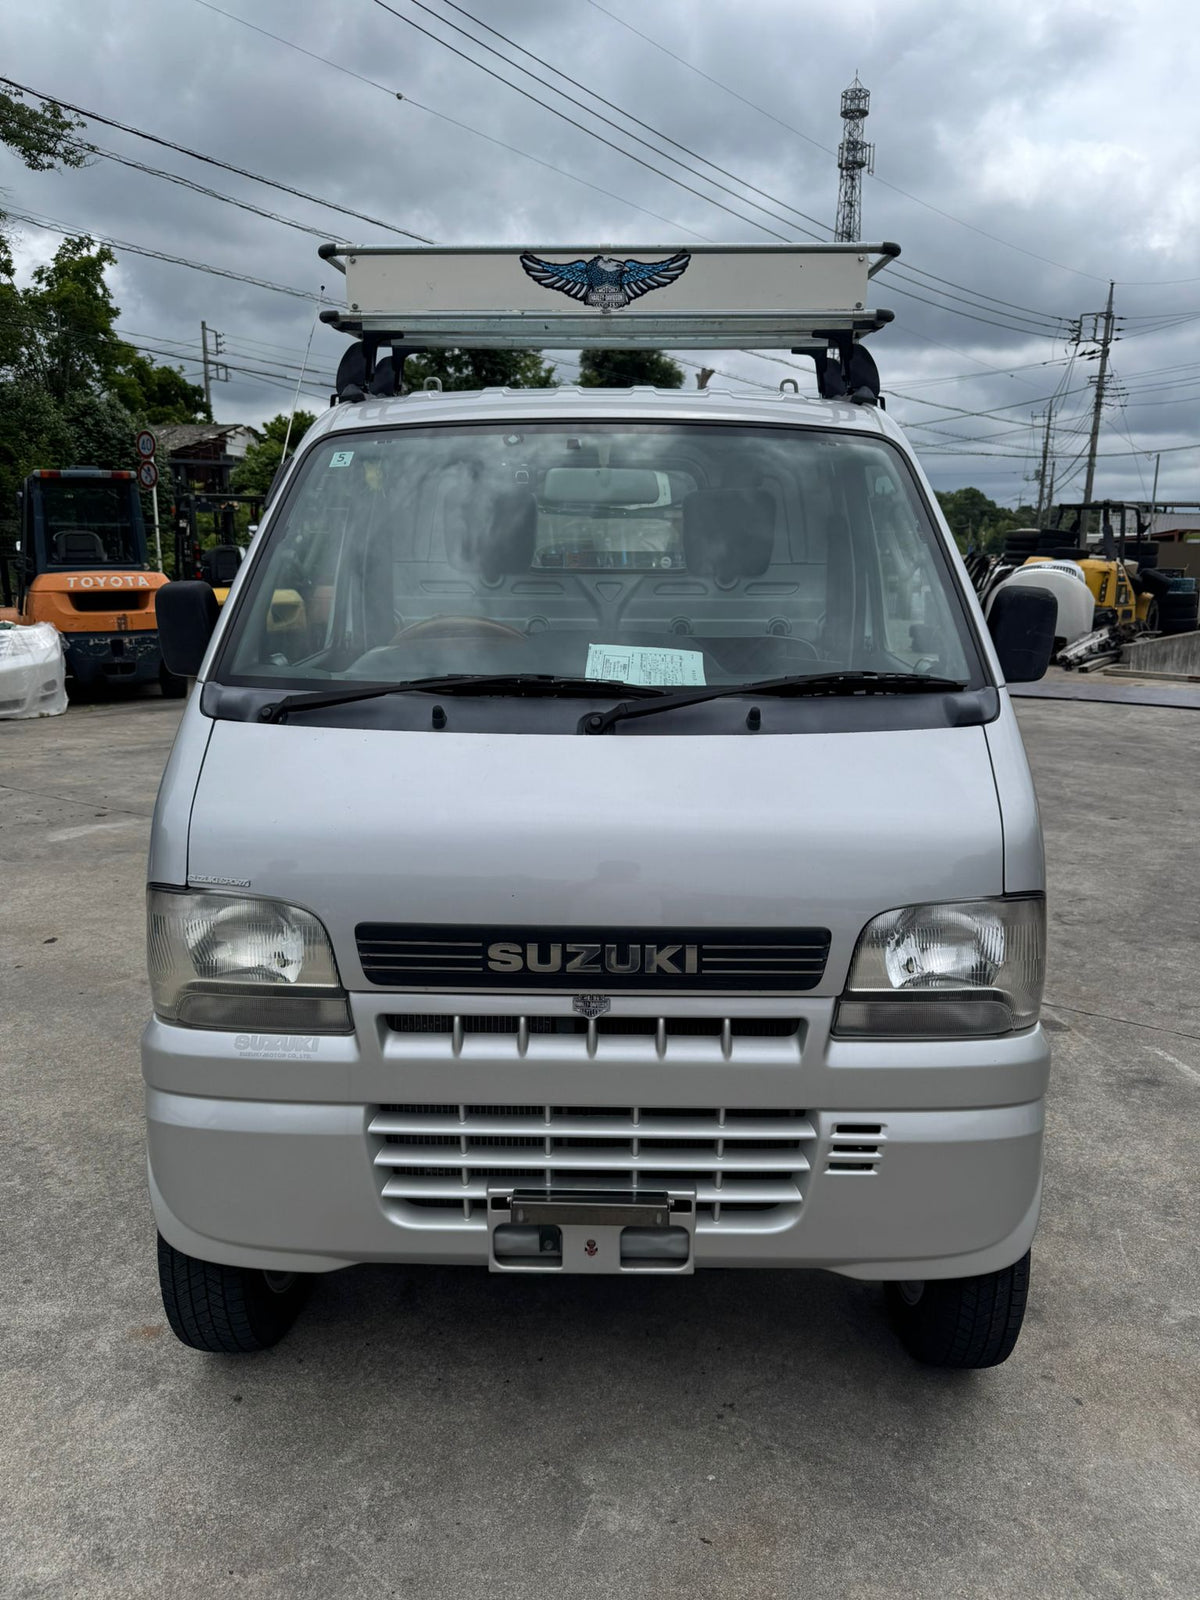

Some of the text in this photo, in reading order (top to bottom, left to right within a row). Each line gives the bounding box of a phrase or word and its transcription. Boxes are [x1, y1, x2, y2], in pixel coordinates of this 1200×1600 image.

[141, 438, 152, 451] 40
[337, 453, 346, 462] 5
[67, 575, 149, 588] TOYOTA
[487, 942, 698, 974] SUZUKI
[233, 1034, 320, 1053] SUZUKI
